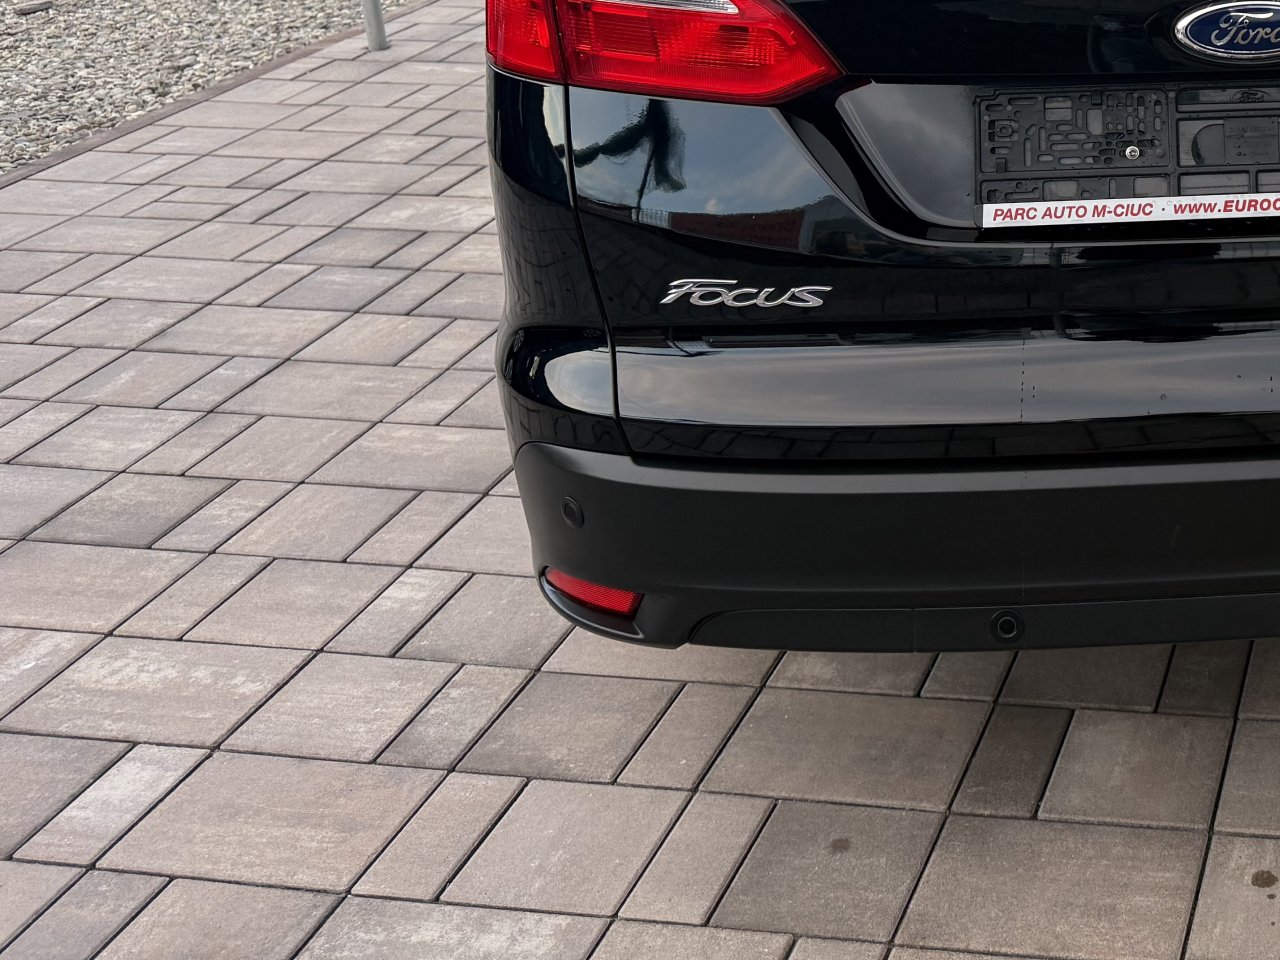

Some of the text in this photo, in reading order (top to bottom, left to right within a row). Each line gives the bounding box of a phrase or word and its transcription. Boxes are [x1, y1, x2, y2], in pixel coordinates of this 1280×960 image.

[992, 206, 1038, 222] PARC
[1041, 204, 1088, 220] AUTO
[1091, 202, 1154, 218] M-CIUC
